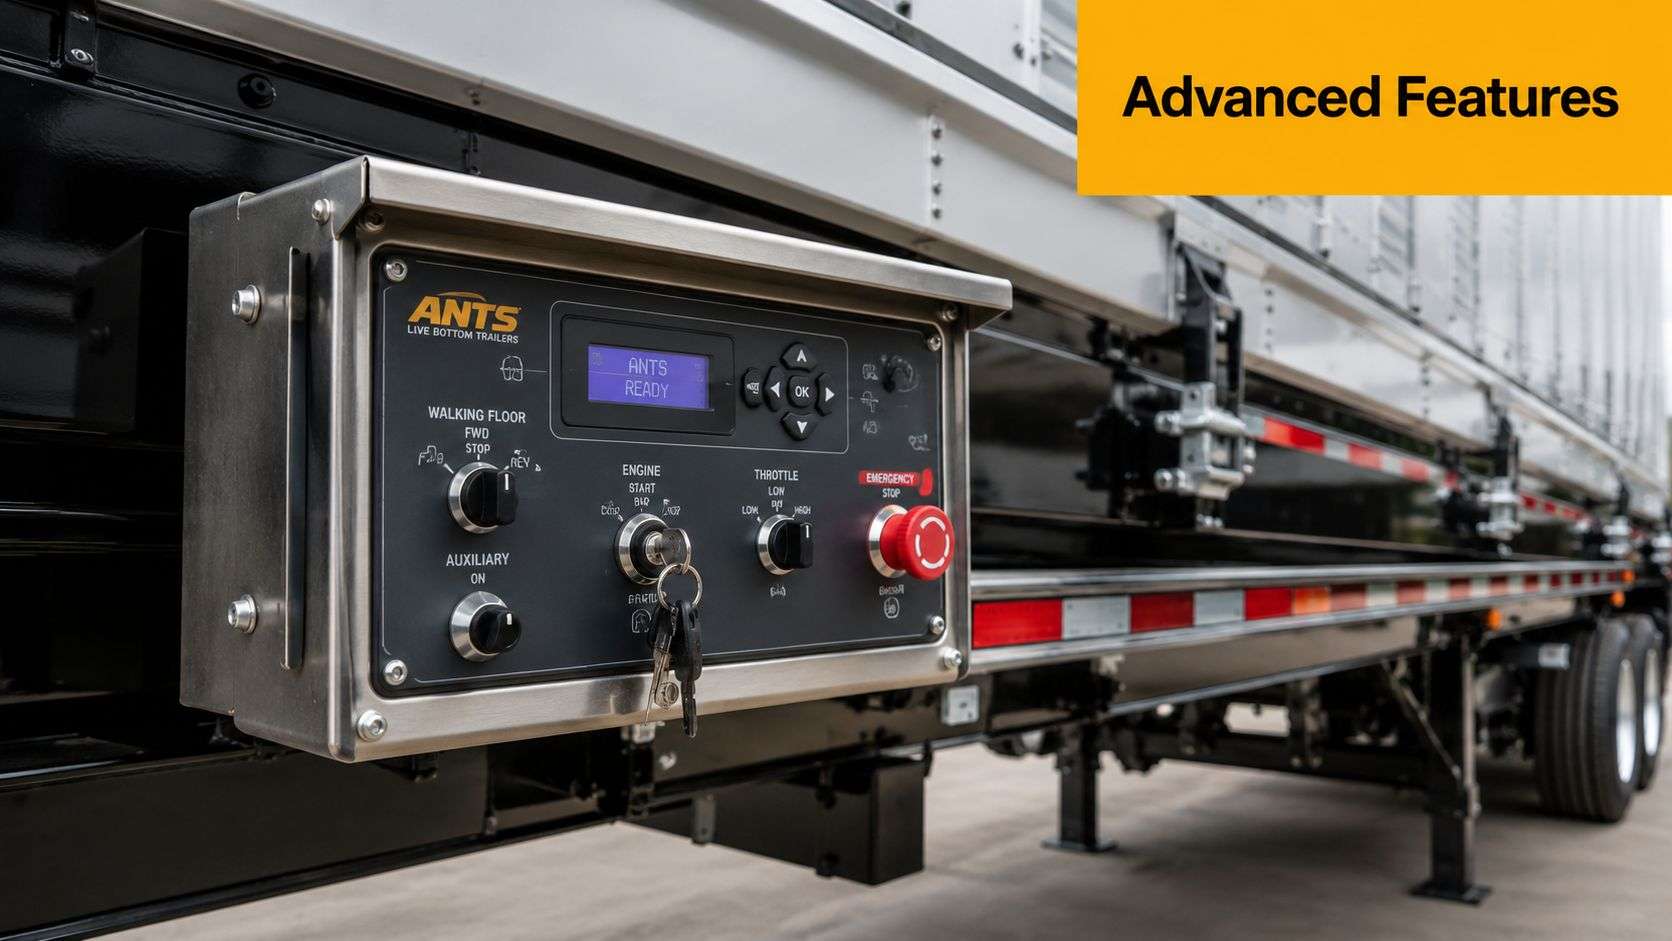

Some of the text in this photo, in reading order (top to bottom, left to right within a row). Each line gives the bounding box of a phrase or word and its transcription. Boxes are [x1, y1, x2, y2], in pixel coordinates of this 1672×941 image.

[407, 295, 520, 332] ANTS
[407, 324, 519, 344] LIVE BOTTOM TRAILERS
[628, 357, 668, 376] ANTS
[625, 379, 669, 399] READY
[794, 385, 810, 398] OK
[428, 406, 526, 423] WALKING FLOOR
[465, 427, 489, 439] FWD
[465, 443, 491, 454] STOP
[622, 464, 661, 477] ENGINE
[754, 469, 799, 481] THROTTLE
[866, 472, 915, 485] EMERGENCY
[629, 483, 656, 494] START
[881, 488, 901, 498] STOP
[446, 553, 510, 567] AUXILIARY
[470, 573, 486, 584] ON
